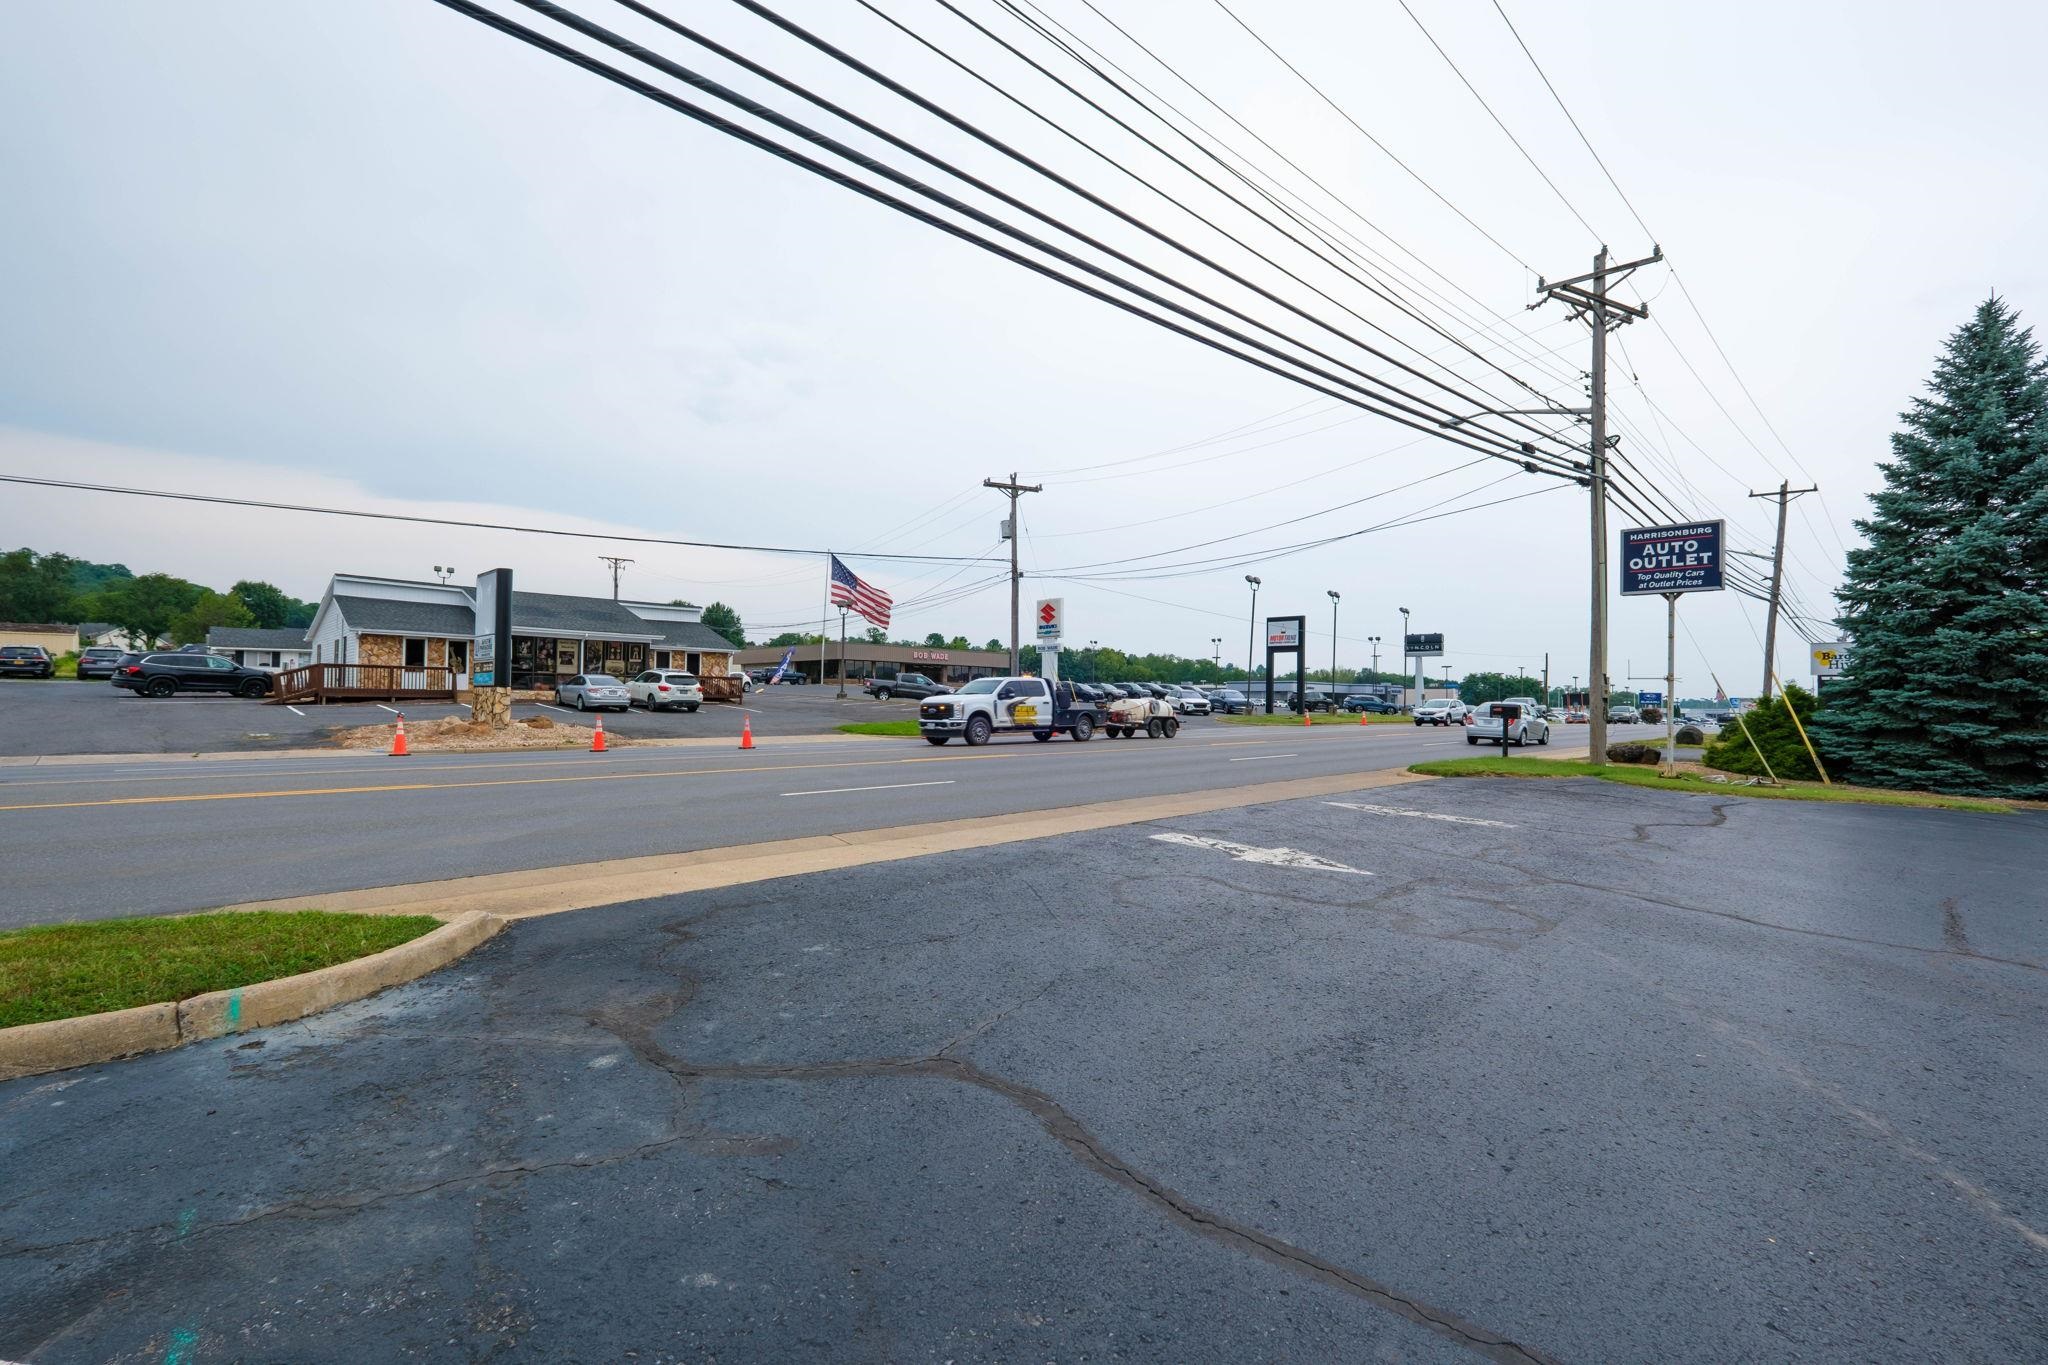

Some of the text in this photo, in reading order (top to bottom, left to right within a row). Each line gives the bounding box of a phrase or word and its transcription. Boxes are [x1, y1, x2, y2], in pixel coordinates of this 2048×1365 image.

[1630, 527, 1712, 540] HARRISONBURG
[1643, 540, 1698, 555] AUTO
[1629, 552, 1712, 569] OUTLET
[1653, 571, 1683, 579] Quality
[913, 651, 949, 660] BOB WADE
